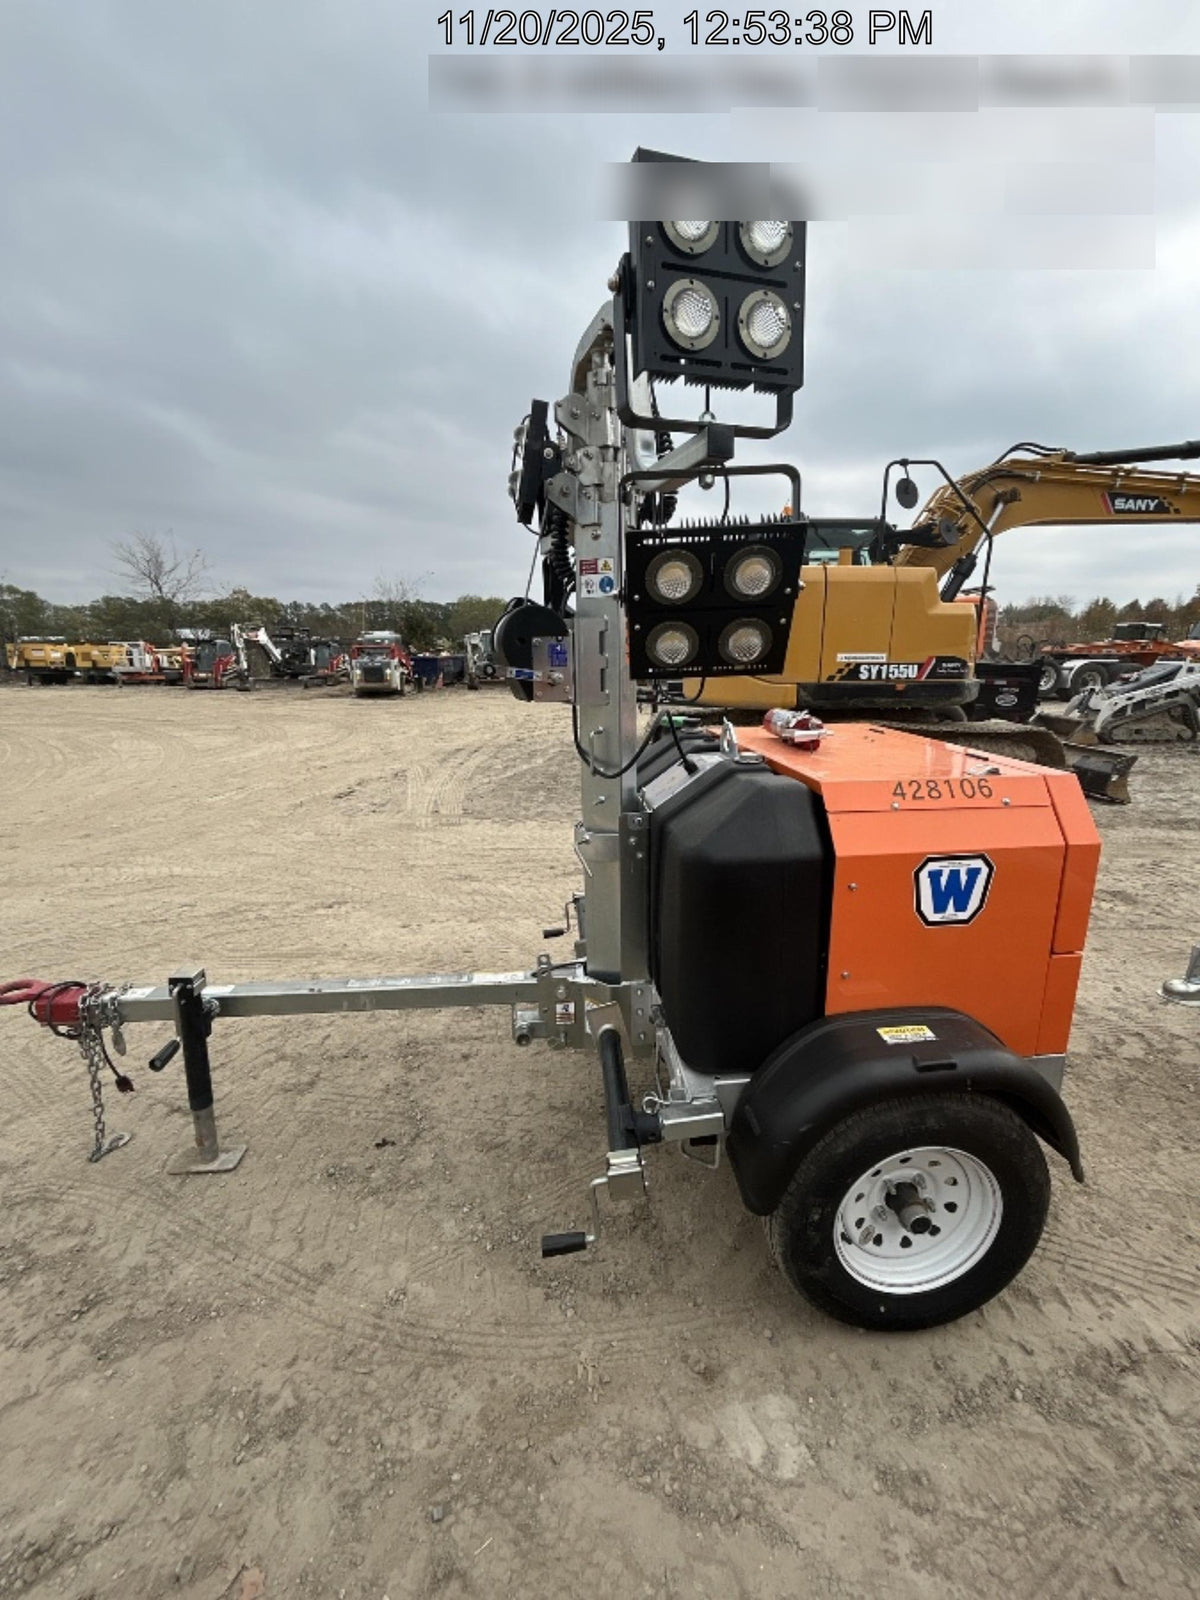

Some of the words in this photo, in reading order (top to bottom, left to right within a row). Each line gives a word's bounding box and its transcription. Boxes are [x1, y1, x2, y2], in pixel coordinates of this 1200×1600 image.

[1114, 498, 1159, 511] SANY
[858, 664, 918, 680] SY155U
[892, 778, 993, 800] 428106
[928, 867, 982, 914] W
